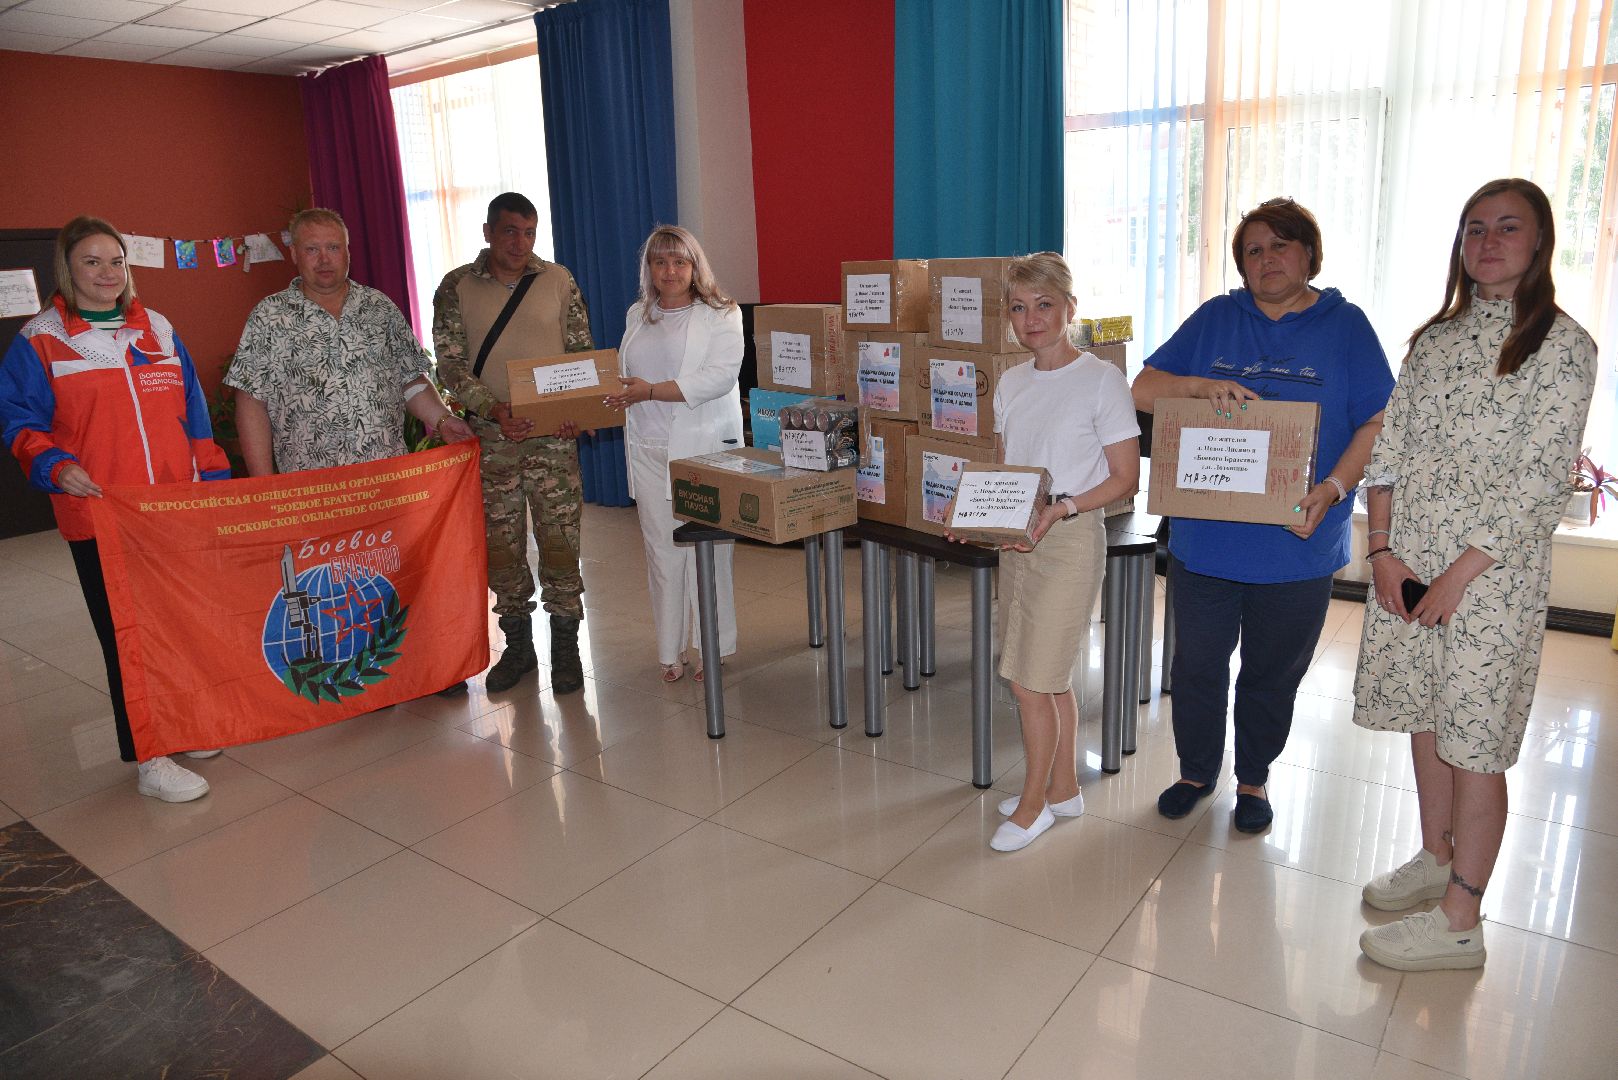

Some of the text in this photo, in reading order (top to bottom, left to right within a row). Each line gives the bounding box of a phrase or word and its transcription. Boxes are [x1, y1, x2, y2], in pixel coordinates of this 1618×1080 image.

[139, 451, 476, 512] ВСЕРОССИЙСКАЯ ОБЩЕСТВЕННАЯ ОРГАНИЗАЦИЯ ВЕТЕРАН
[678, 489, 714, 506] ВКУСНАЯ
[217, 490, 430, 536] МОСКОВСКОЕ ОБЛАСТНОЕ ОТДЕЛЕНИЕ
[684, 500, 709, 513] ПАУЗА
[297, 530, 393, 559] Боевое
[330, 545, 400, 584] БРАТСТВО
